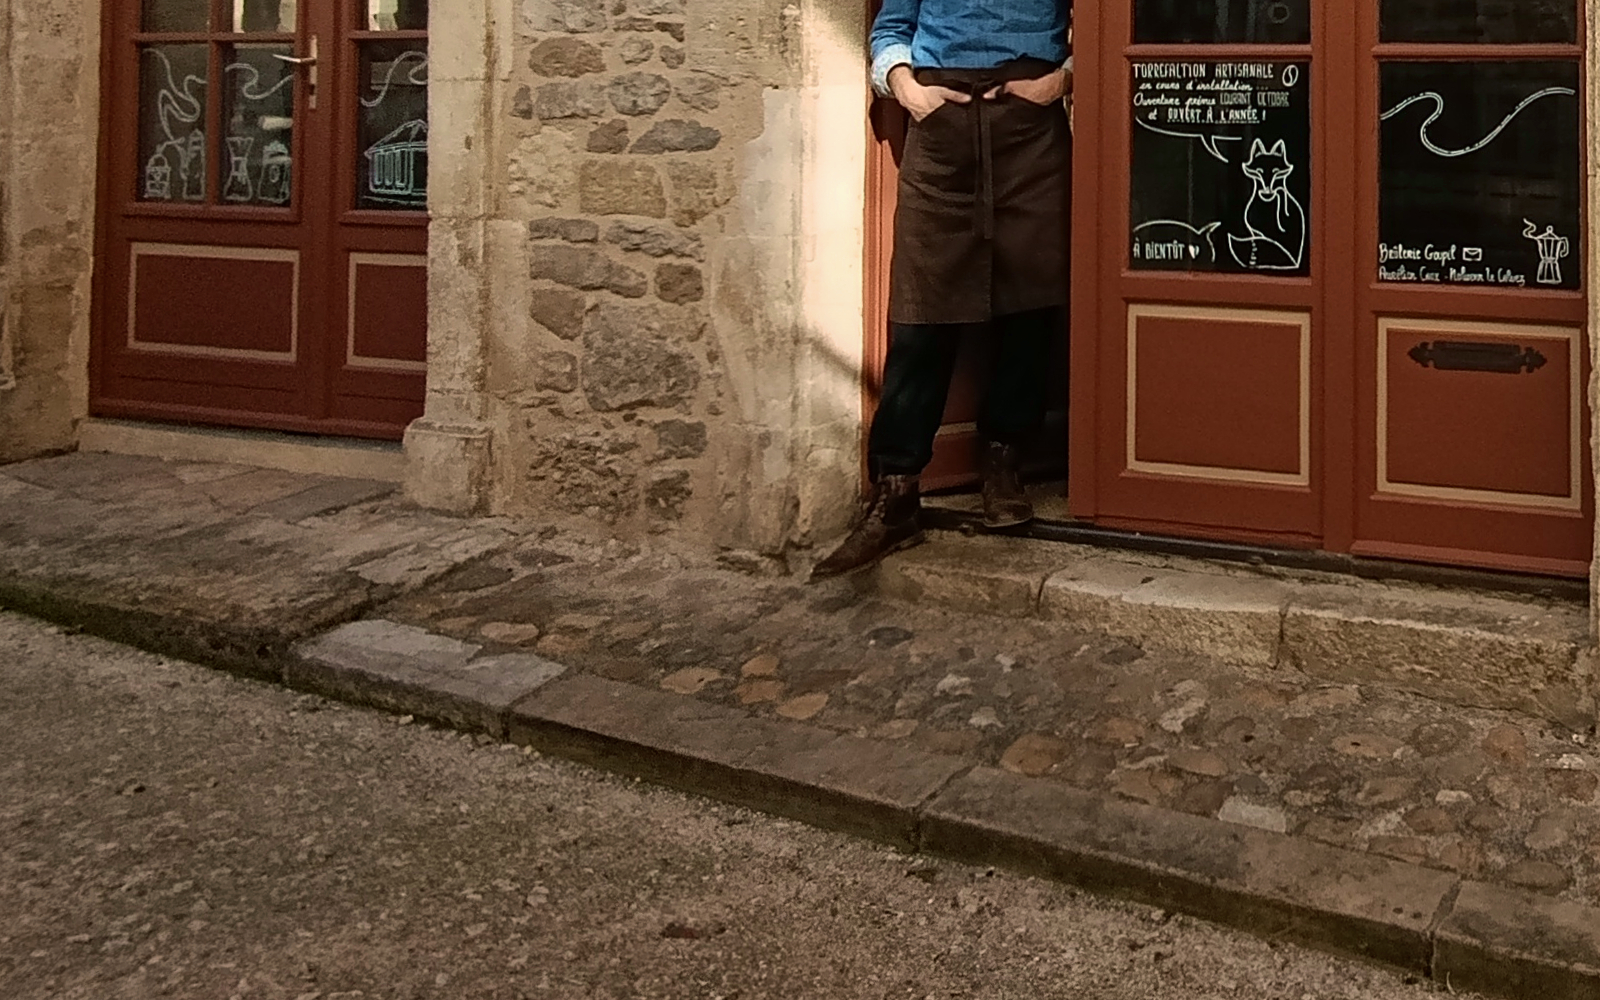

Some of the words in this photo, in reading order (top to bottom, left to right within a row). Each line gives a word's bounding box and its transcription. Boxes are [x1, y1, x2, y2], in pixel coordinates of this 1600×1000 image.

[1215, 63, 1274, 79] ARTISANALE
[1156, 81, 1180, 90] cours
[1133, 92, 1180, 107] Ouverture
